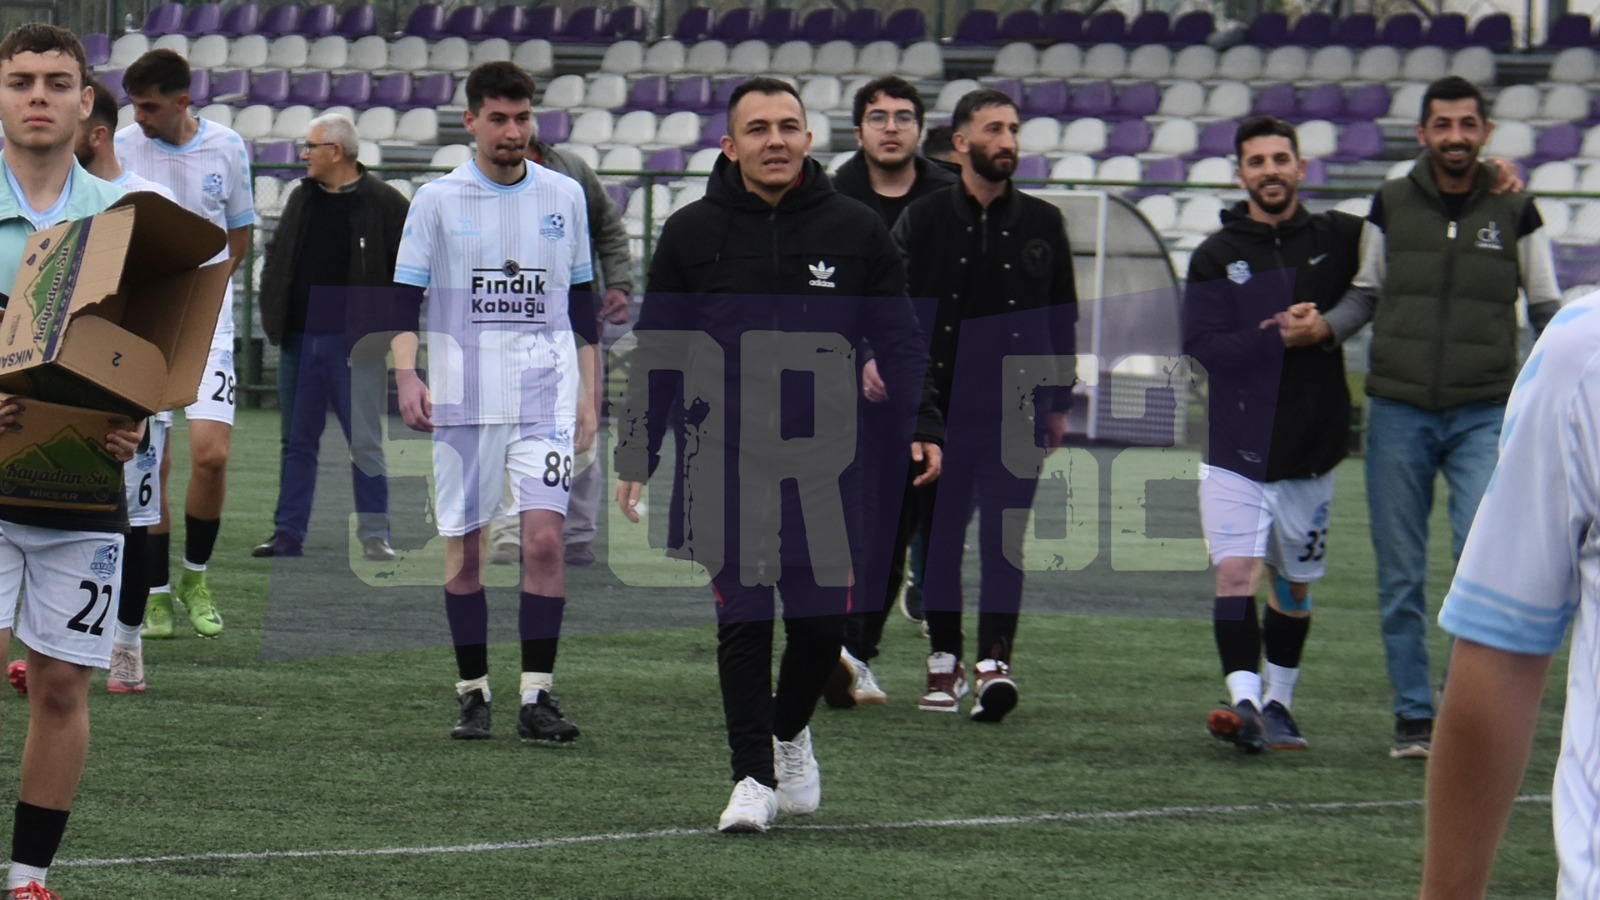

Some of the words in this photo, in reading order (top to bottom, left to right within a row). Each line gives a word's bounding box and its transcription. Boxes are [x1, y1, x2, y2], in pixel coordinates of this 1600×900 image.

[33, 270, 63, 343] Kayadan
[55, 246, 70, 268] Su
[471, 274, 546, 295] Fındık
[808, 279, 836, 288] adidas
[211, 370, 236, 406] 28
[5, 463, 82, 485] Kayadan
[542, 450, 572, 493] 88
[138, 472, 153, 507] 6
[1297, 529, 1328, 563] 33
[67, 580, 113, 637] 22
